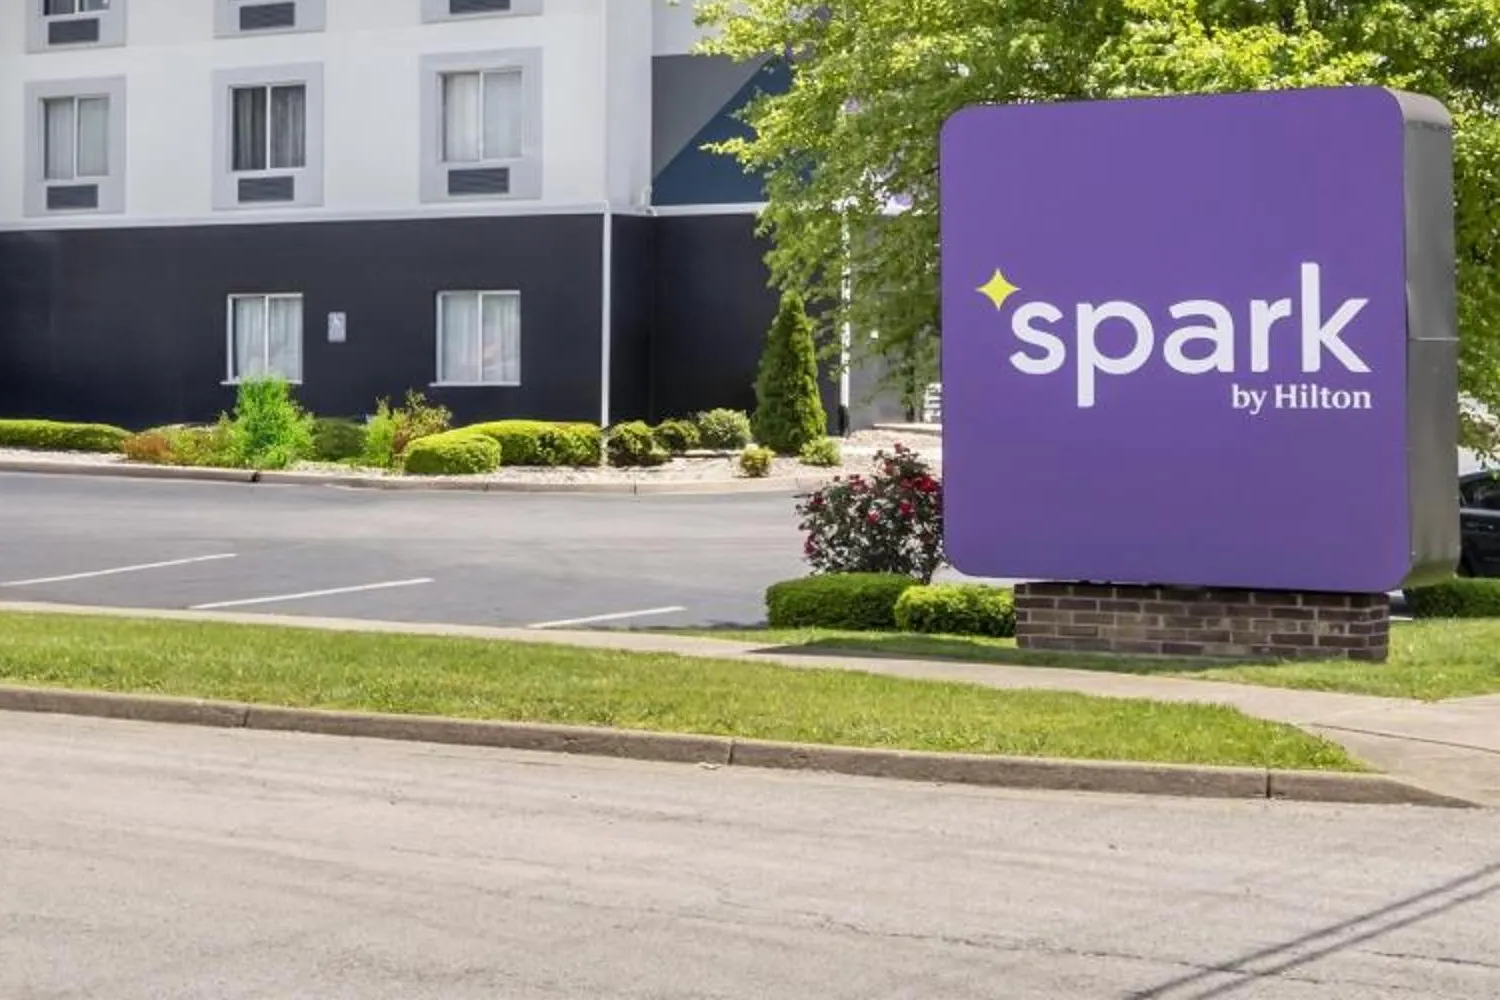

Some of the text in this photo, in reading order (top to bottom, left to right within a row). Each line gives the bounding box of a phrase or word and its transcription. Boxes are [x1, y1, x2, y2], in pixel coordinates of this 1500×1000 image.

[1009, 262, 1372, 407] spark
[1231, 384, 1373, 414] by Hilton
